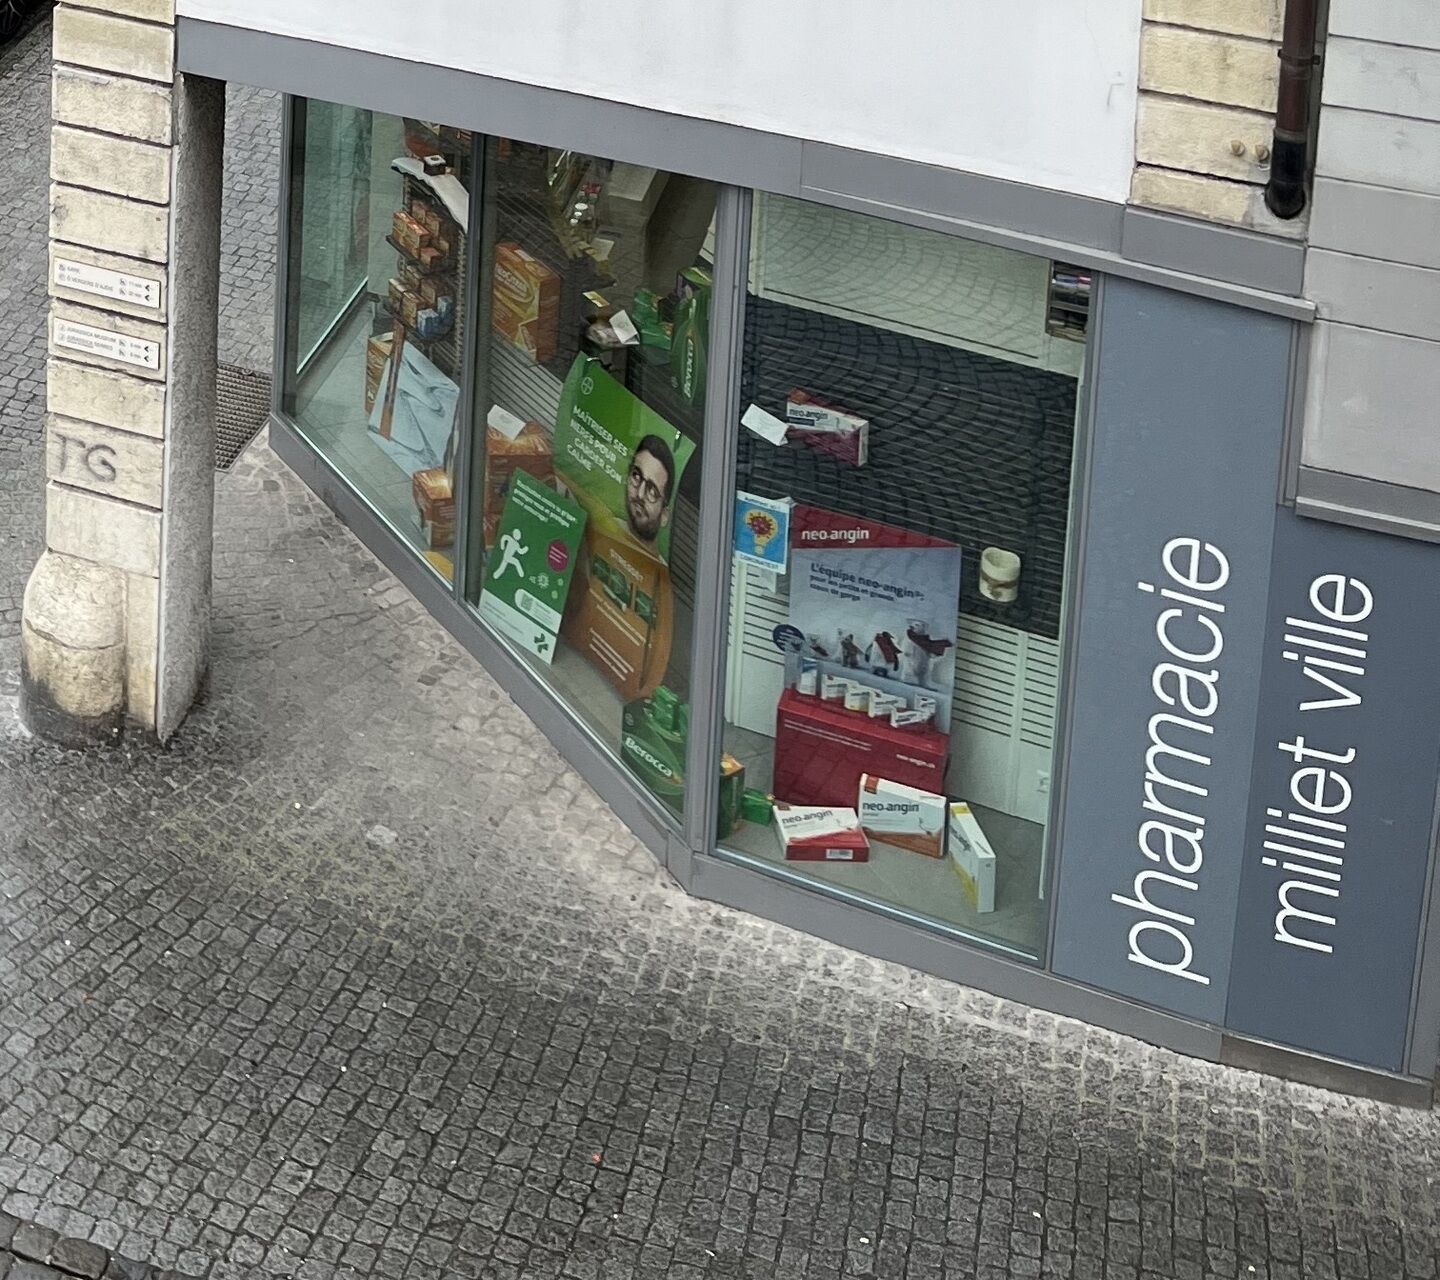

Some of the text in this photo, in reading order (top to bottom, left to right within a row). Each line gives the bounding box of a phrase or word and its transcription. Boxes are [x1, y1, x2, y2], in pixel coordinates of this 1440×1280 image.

[811, 562, 856, 583] L'équipe
[625, 736, 672, 778] Berocca
[1111, 536, 1231, 985] pharmacie
[1261, 573, 1374, 954] milliet ville
